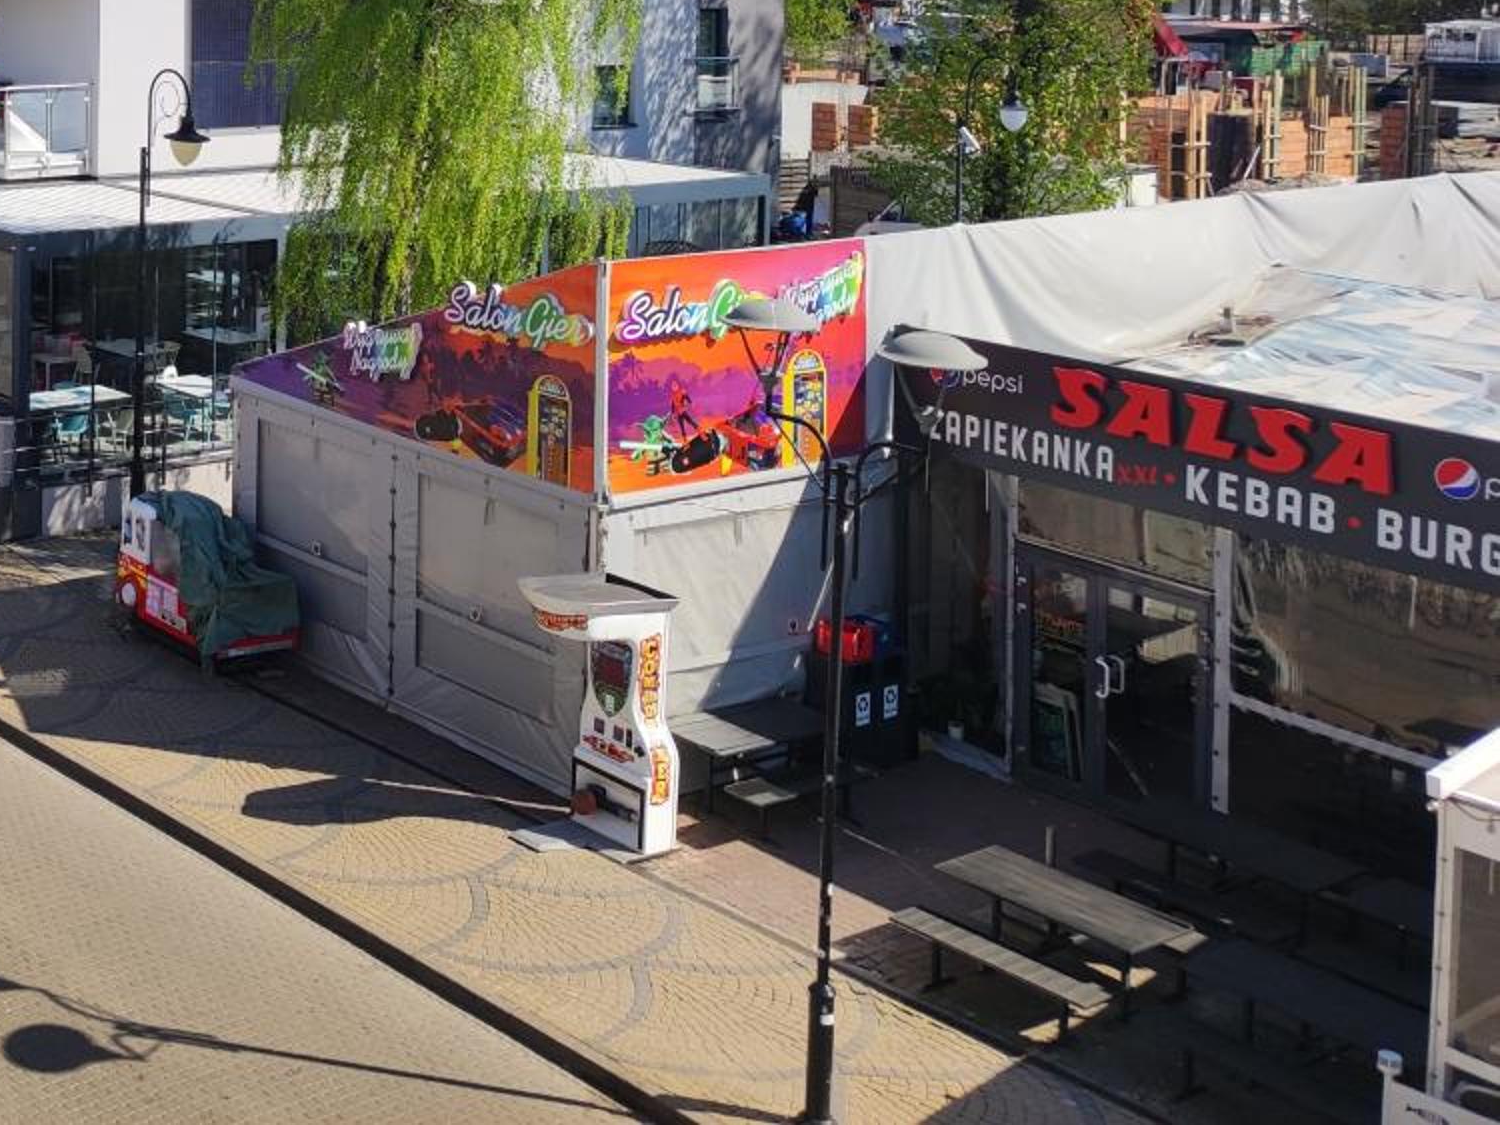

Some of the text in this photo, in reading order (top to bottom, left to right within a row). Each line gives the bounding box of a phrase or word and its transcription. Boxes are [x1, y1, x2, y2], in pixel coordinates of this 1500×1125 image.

[445, 283, 593, 348] Salon Gier
[618, 285, 707, 340] Salon
[962, 369, 1024, 393] pepsi
[1051, 366, 1394, 495] SALSA
[1185, 464, 1335, 534] KEBAB
